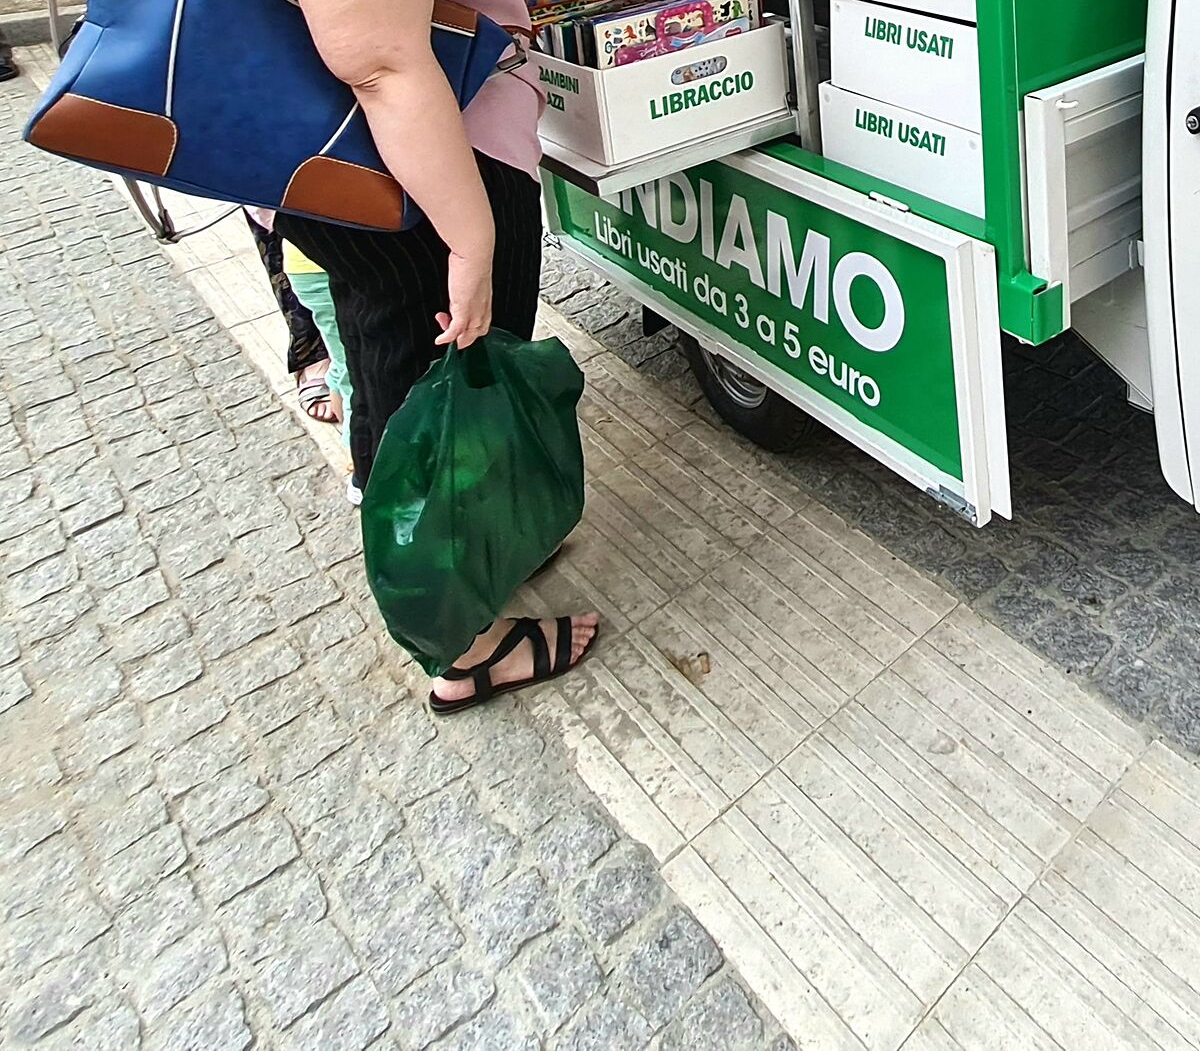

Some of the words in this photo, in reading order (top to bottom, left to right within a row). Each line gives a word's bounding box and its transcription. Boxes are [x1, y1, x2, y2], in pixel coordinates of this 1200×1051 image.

[864, 16, 901, 45] LIBRI
[906, 27, 954, 59] USATI
[649, 70, 754, 119] LIBRACCIO
[855, 108, 893, 138] LIBRI
[898, 121, 946, 156] USATI
[594, 211, 632, 260] Libri
[637, 246, 688, 293] usati
[694, 272, 727, 316] da
[734, 293, 749, 329] 3
[757, 314, 775, 346] a
[783, 320, 801, 359] 5
[808, 345, 881, 408] euro
